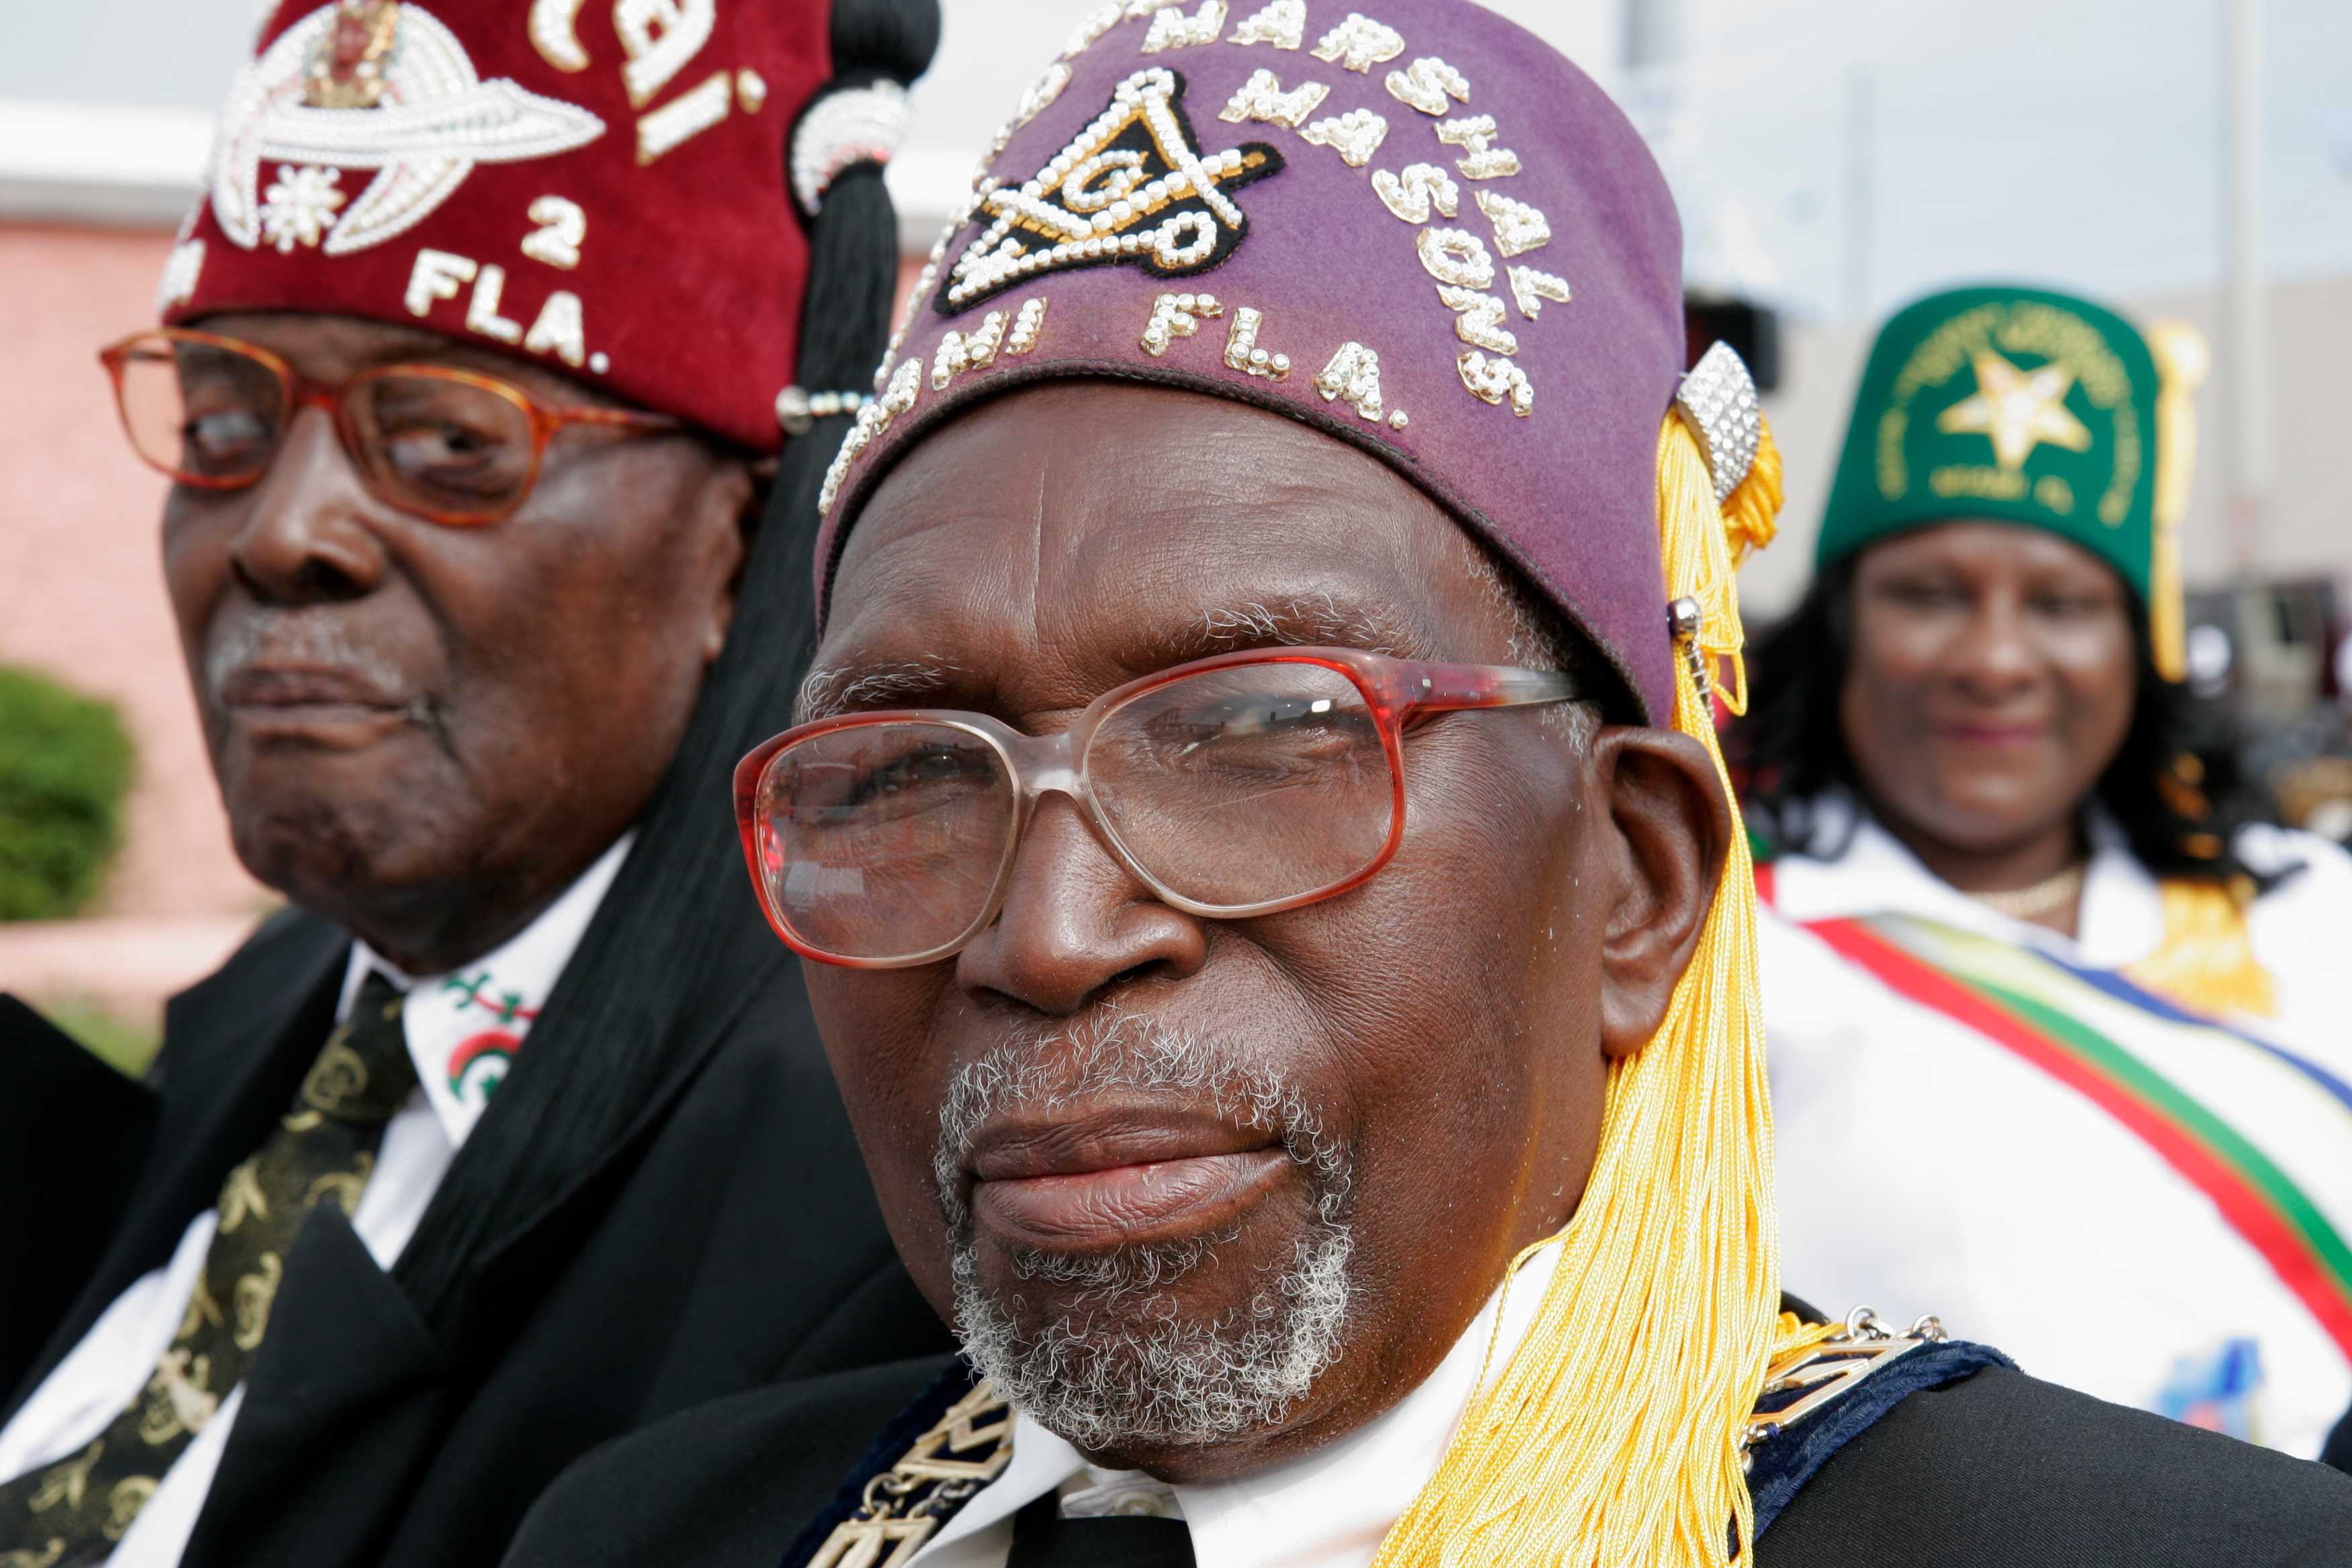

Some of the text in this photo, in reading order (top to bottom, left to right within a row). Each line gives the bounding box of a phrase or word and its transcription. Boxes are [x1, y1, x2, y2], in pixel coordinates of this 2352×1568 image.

[520, 194, 587, 271] 2
[1216, 68, 1534, 418] MASONS
[404, 247, 611, 375] FLA.
[1140, 291, 1409, 432] FLA.
